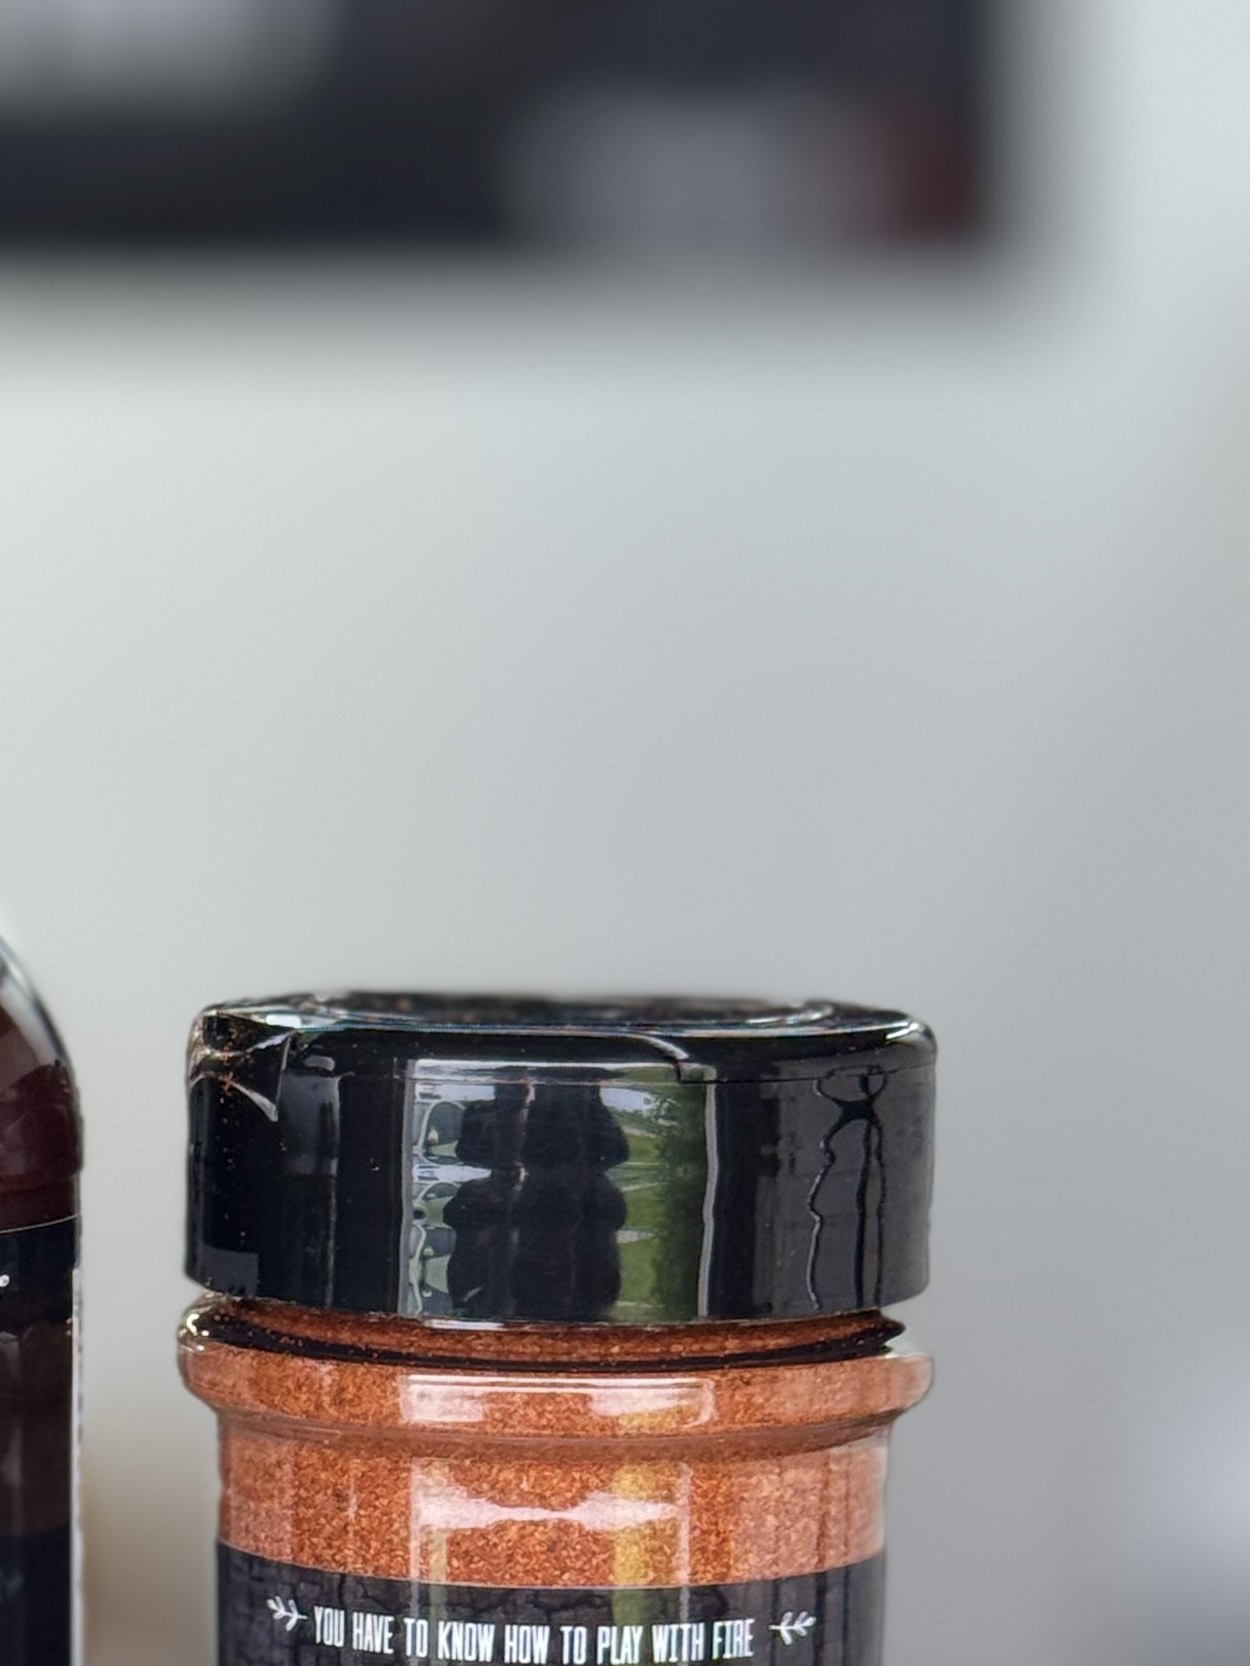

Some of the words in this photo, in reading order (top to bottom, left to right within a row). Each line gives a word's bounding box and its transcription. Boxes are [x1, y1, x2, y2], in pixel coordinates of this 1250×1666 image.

[313, 1606, 346, 1648] YOU
[352, 1612, 394, 1655] HAVE
[403, 1617, 429, 1659] TO
[437, 1620, 496, 1663] KNOW
[503, 1624, 550, 1665] HOW
[560, 1625, 587, 1665] TO
[597, 1625, 644, 1665] PLAY
[652, 1621, 704, 1664] WITH
[712, 1618, 756, 1660] FIRE
